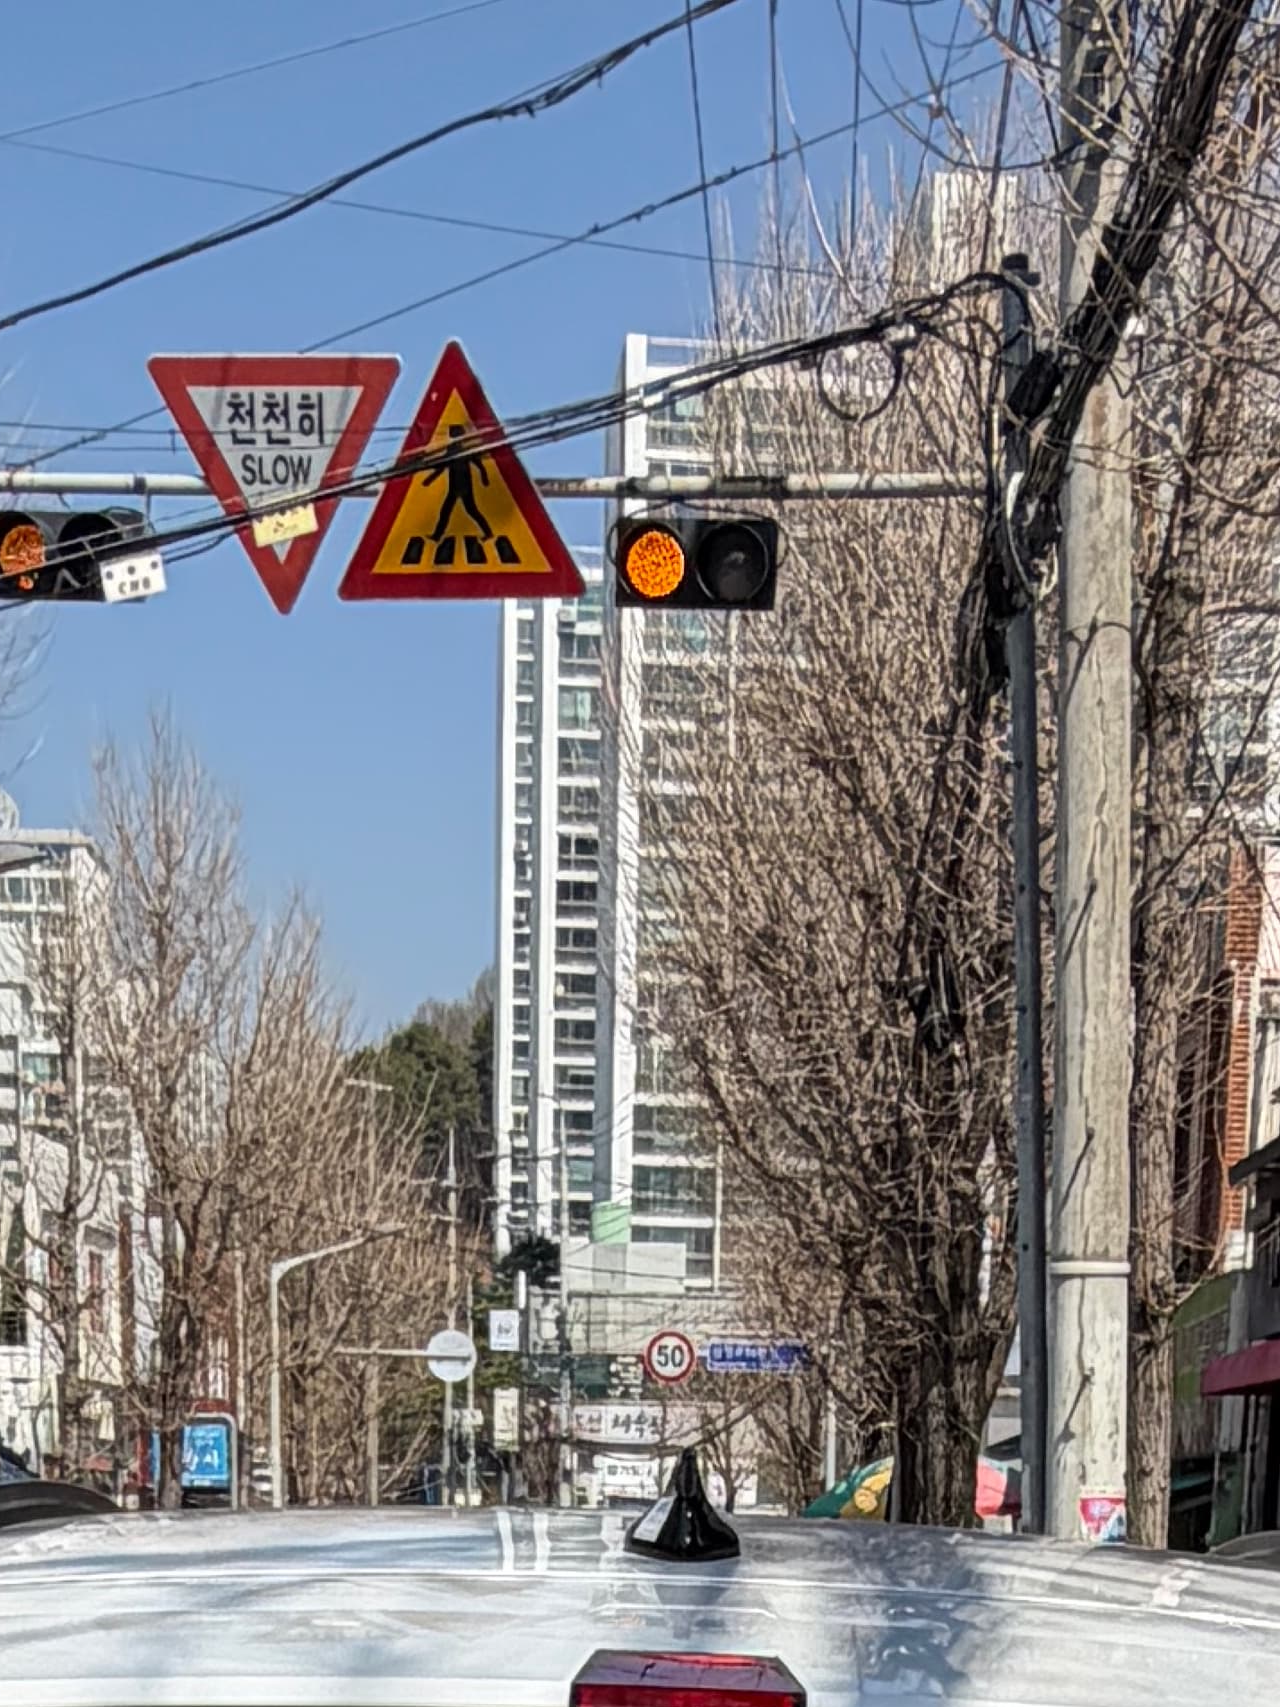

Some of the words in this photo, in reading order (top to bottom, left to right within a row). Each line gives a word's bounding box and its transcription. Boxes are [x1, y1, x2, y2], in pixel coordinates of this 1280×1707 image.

[226, 391, 326, 446] 천천히
[241, 453, 312, 486] SLOW
[656, 1344, 685, 1369] 50
